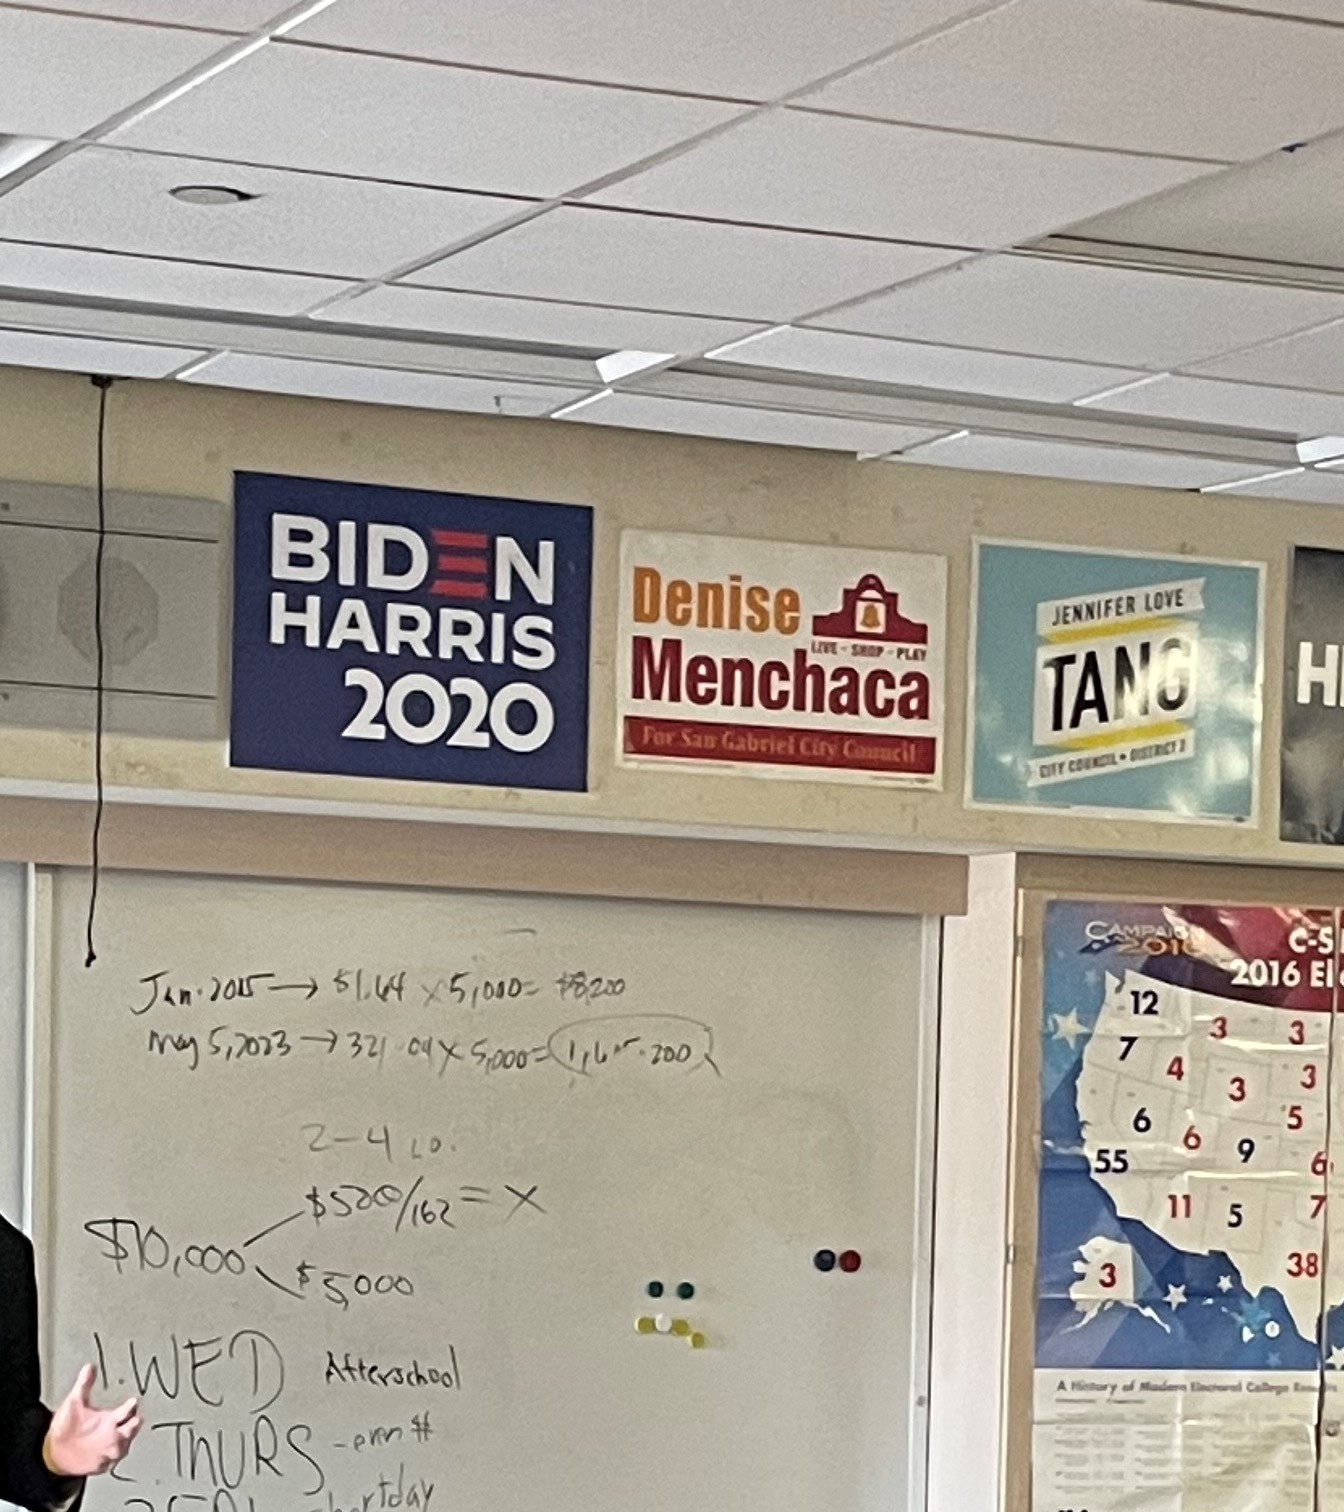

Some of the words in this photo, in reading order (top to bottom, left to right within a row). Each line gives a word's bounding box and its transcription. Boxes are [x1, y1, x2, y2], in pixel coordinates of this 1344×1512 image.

[271, 512, 554, 605] BIDEN
[632, 565, 801, 636] Denise
[1052, 595, 1136, 626] JENNIFER
[1144, 588, 1184, 612] LOVE
[270, 591, 554, 671] HARRIS
[632, 634, 930, 721] Menchaca
[1043, 637, 1192, 731] TANG
[341, 667, 554, 753] 2020
[642, 724, 675, 747] For
[680, 728, 716, 749] San
[721, 731, 796, 754] Gabriel
[799, 736, 840, 760] City
[843, 739, 916, 764] Council
[1039, 760, 1065, 779] CITY
[1230, 959, 1301, 987] 2016
[1130, 991, 1159, 1015] 12
[1210, 1016, 1228, 1040] 3
[1289, 1020, 1305, 1045] 3
[1119, 1036, 1138, 1061] 7
[1166, 1056, 1184, 1081] 4
[1300, 1064, 1317, 1090] 3
[1229, 1076, 1246, 1102] 3
[1133, 1107, 1152, 1133] 6
[1287, 1105, 1303, 1130] 5
[1182, 1125, 1202, 1150] 6
[1094, 1149, 1129, 1174] 55
[1237, 1138, 1256, 1163] 9
[1311, 1151, 1328, 1176] 6
[1167, 1194, 1192, 1218] 11
[1227, 1203, 1243, 1228] 5
[1310, 1194, 1328, 1219] 7
[84, 1217, 246, 1276] $10,000
[1099, 1262, 1117, 1288] 3
[1286, 1252, 1319, 1277] 38
